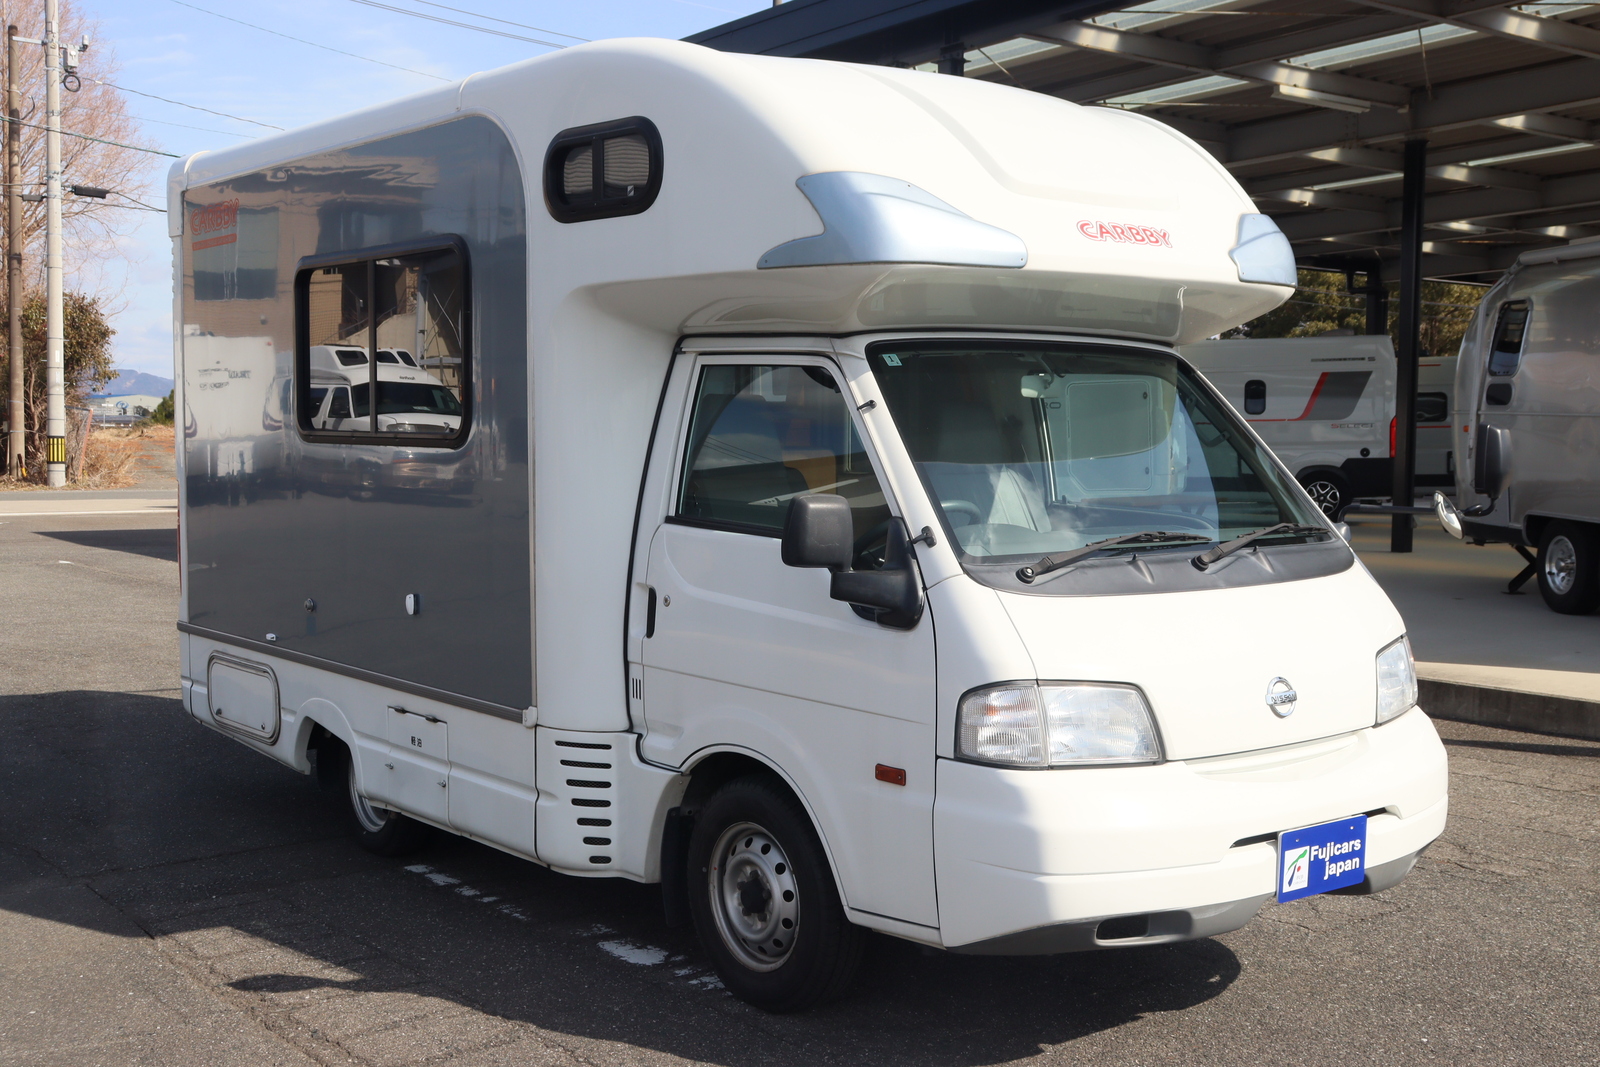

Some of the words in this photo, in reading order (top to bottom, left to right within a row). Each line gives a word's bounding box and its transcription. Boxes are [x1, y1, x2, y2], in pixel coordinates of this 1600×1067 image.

[190, 197, 240, 236] CARBBY
[1076, 220, 1173, 248] CARBBY
[1270, 693, 1297, 703] NISSAN
[1310, 839, 1362, 862] Fujicars
[1323, 857, 1360, 880] japan
